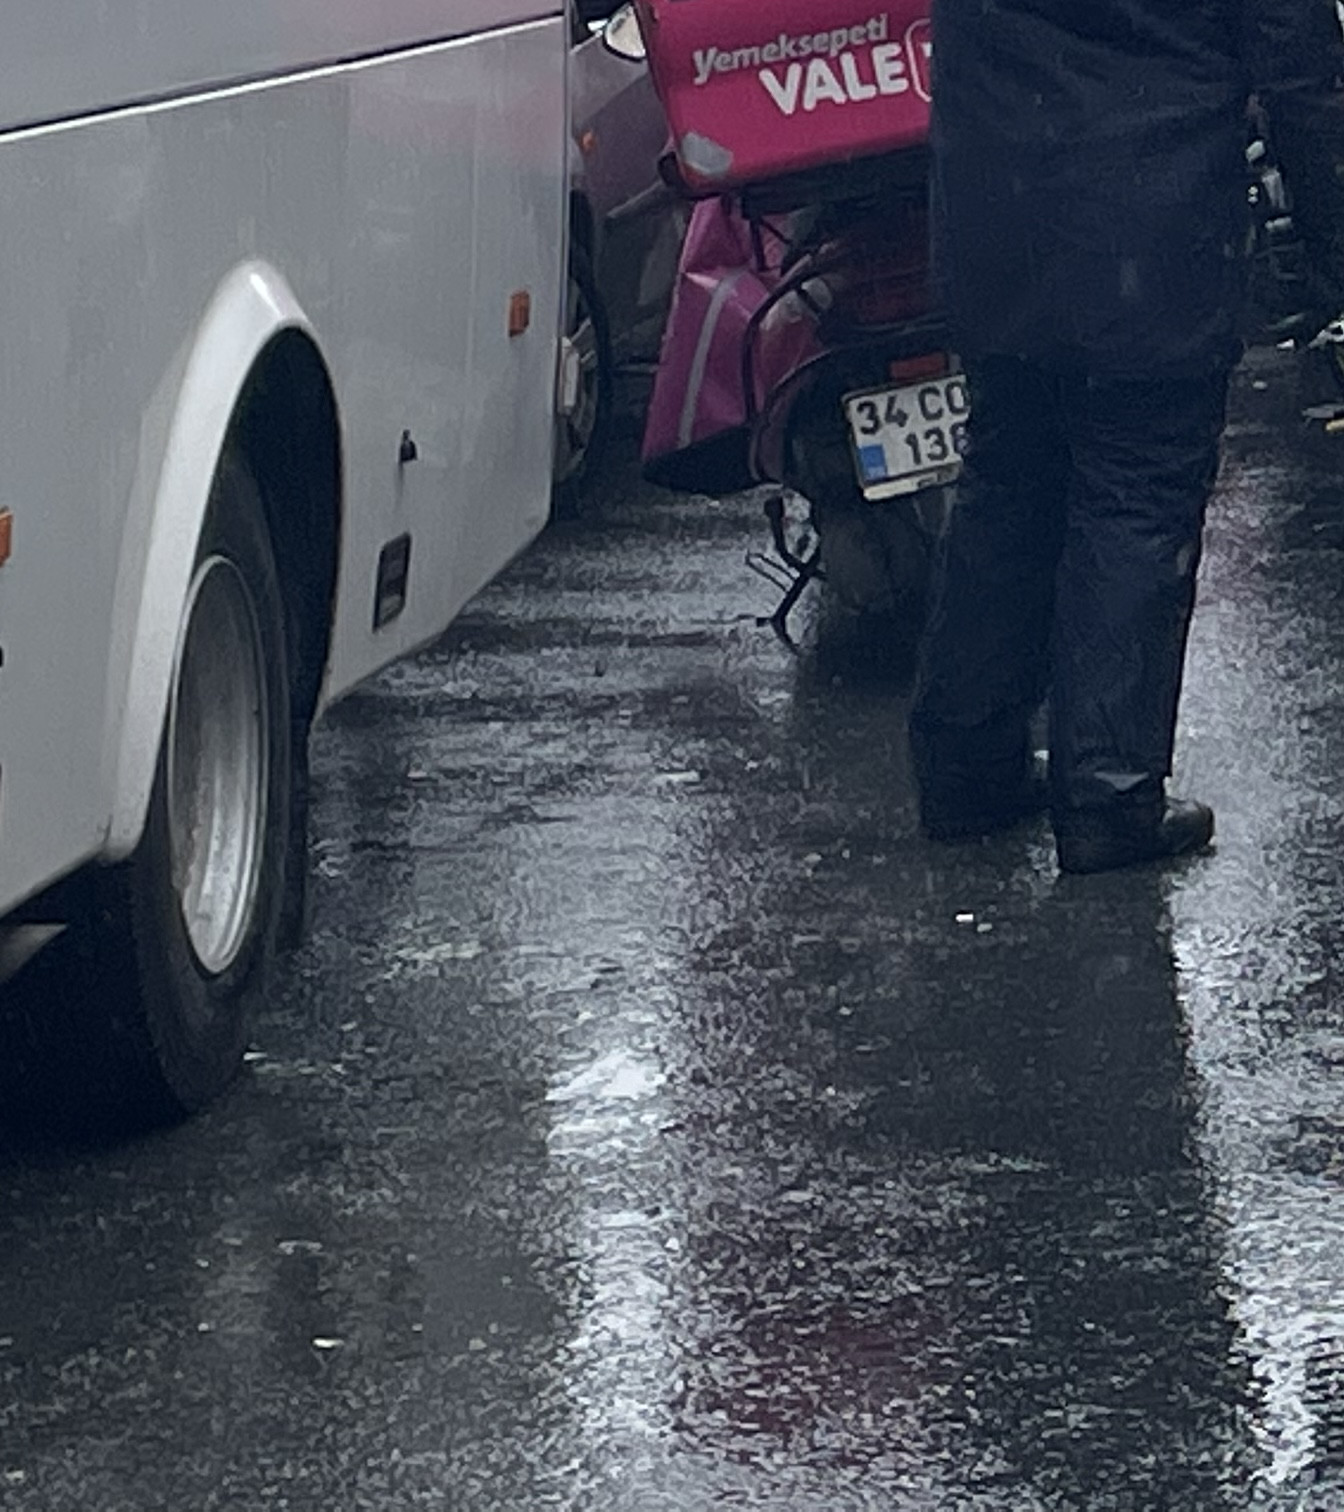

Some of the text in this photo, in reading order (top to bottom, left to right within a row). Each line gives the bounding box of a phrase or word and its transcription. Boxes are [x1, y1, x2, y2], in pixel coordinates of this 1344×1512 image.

[692, 12, 889, 86] Yemeksepeti
[758, 41, 909, 115] VALE
[856, 394, 908, 436] 34
